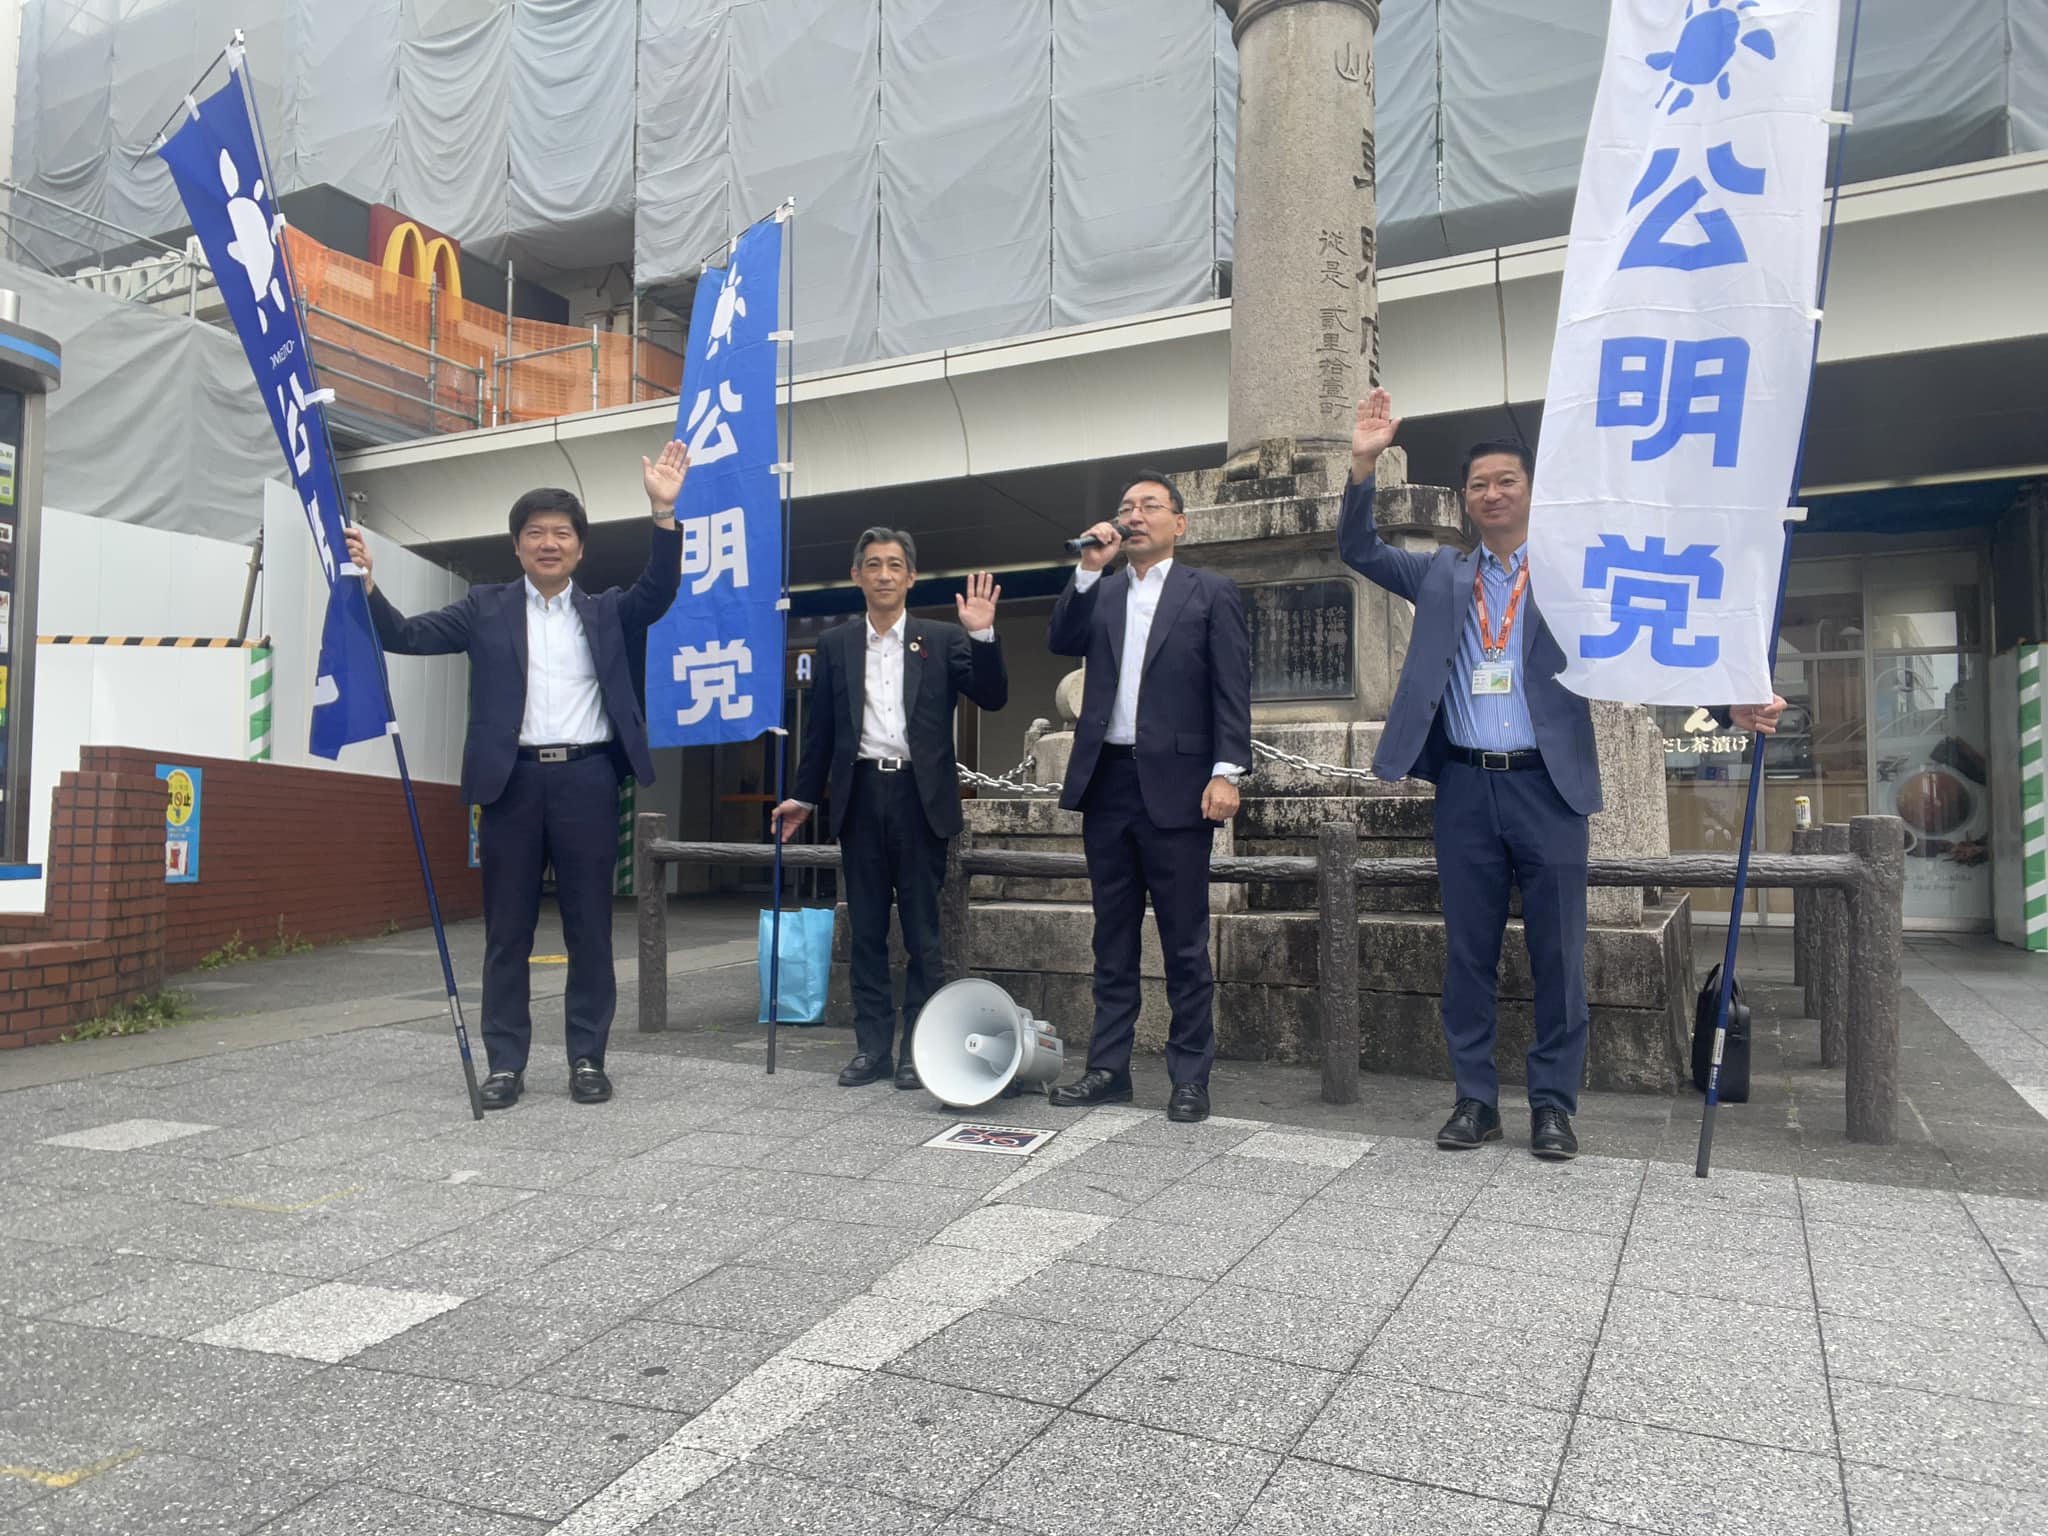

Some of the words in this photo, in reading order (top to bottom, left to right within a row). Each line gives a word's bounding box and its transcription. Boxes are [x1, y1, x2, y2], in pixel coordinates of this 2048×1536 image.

[672, 379, 753, 726] 公明党
[1580, 142, 1766, 668] 公明党
[1662, 735, 1749, 753] だし茶漬け
